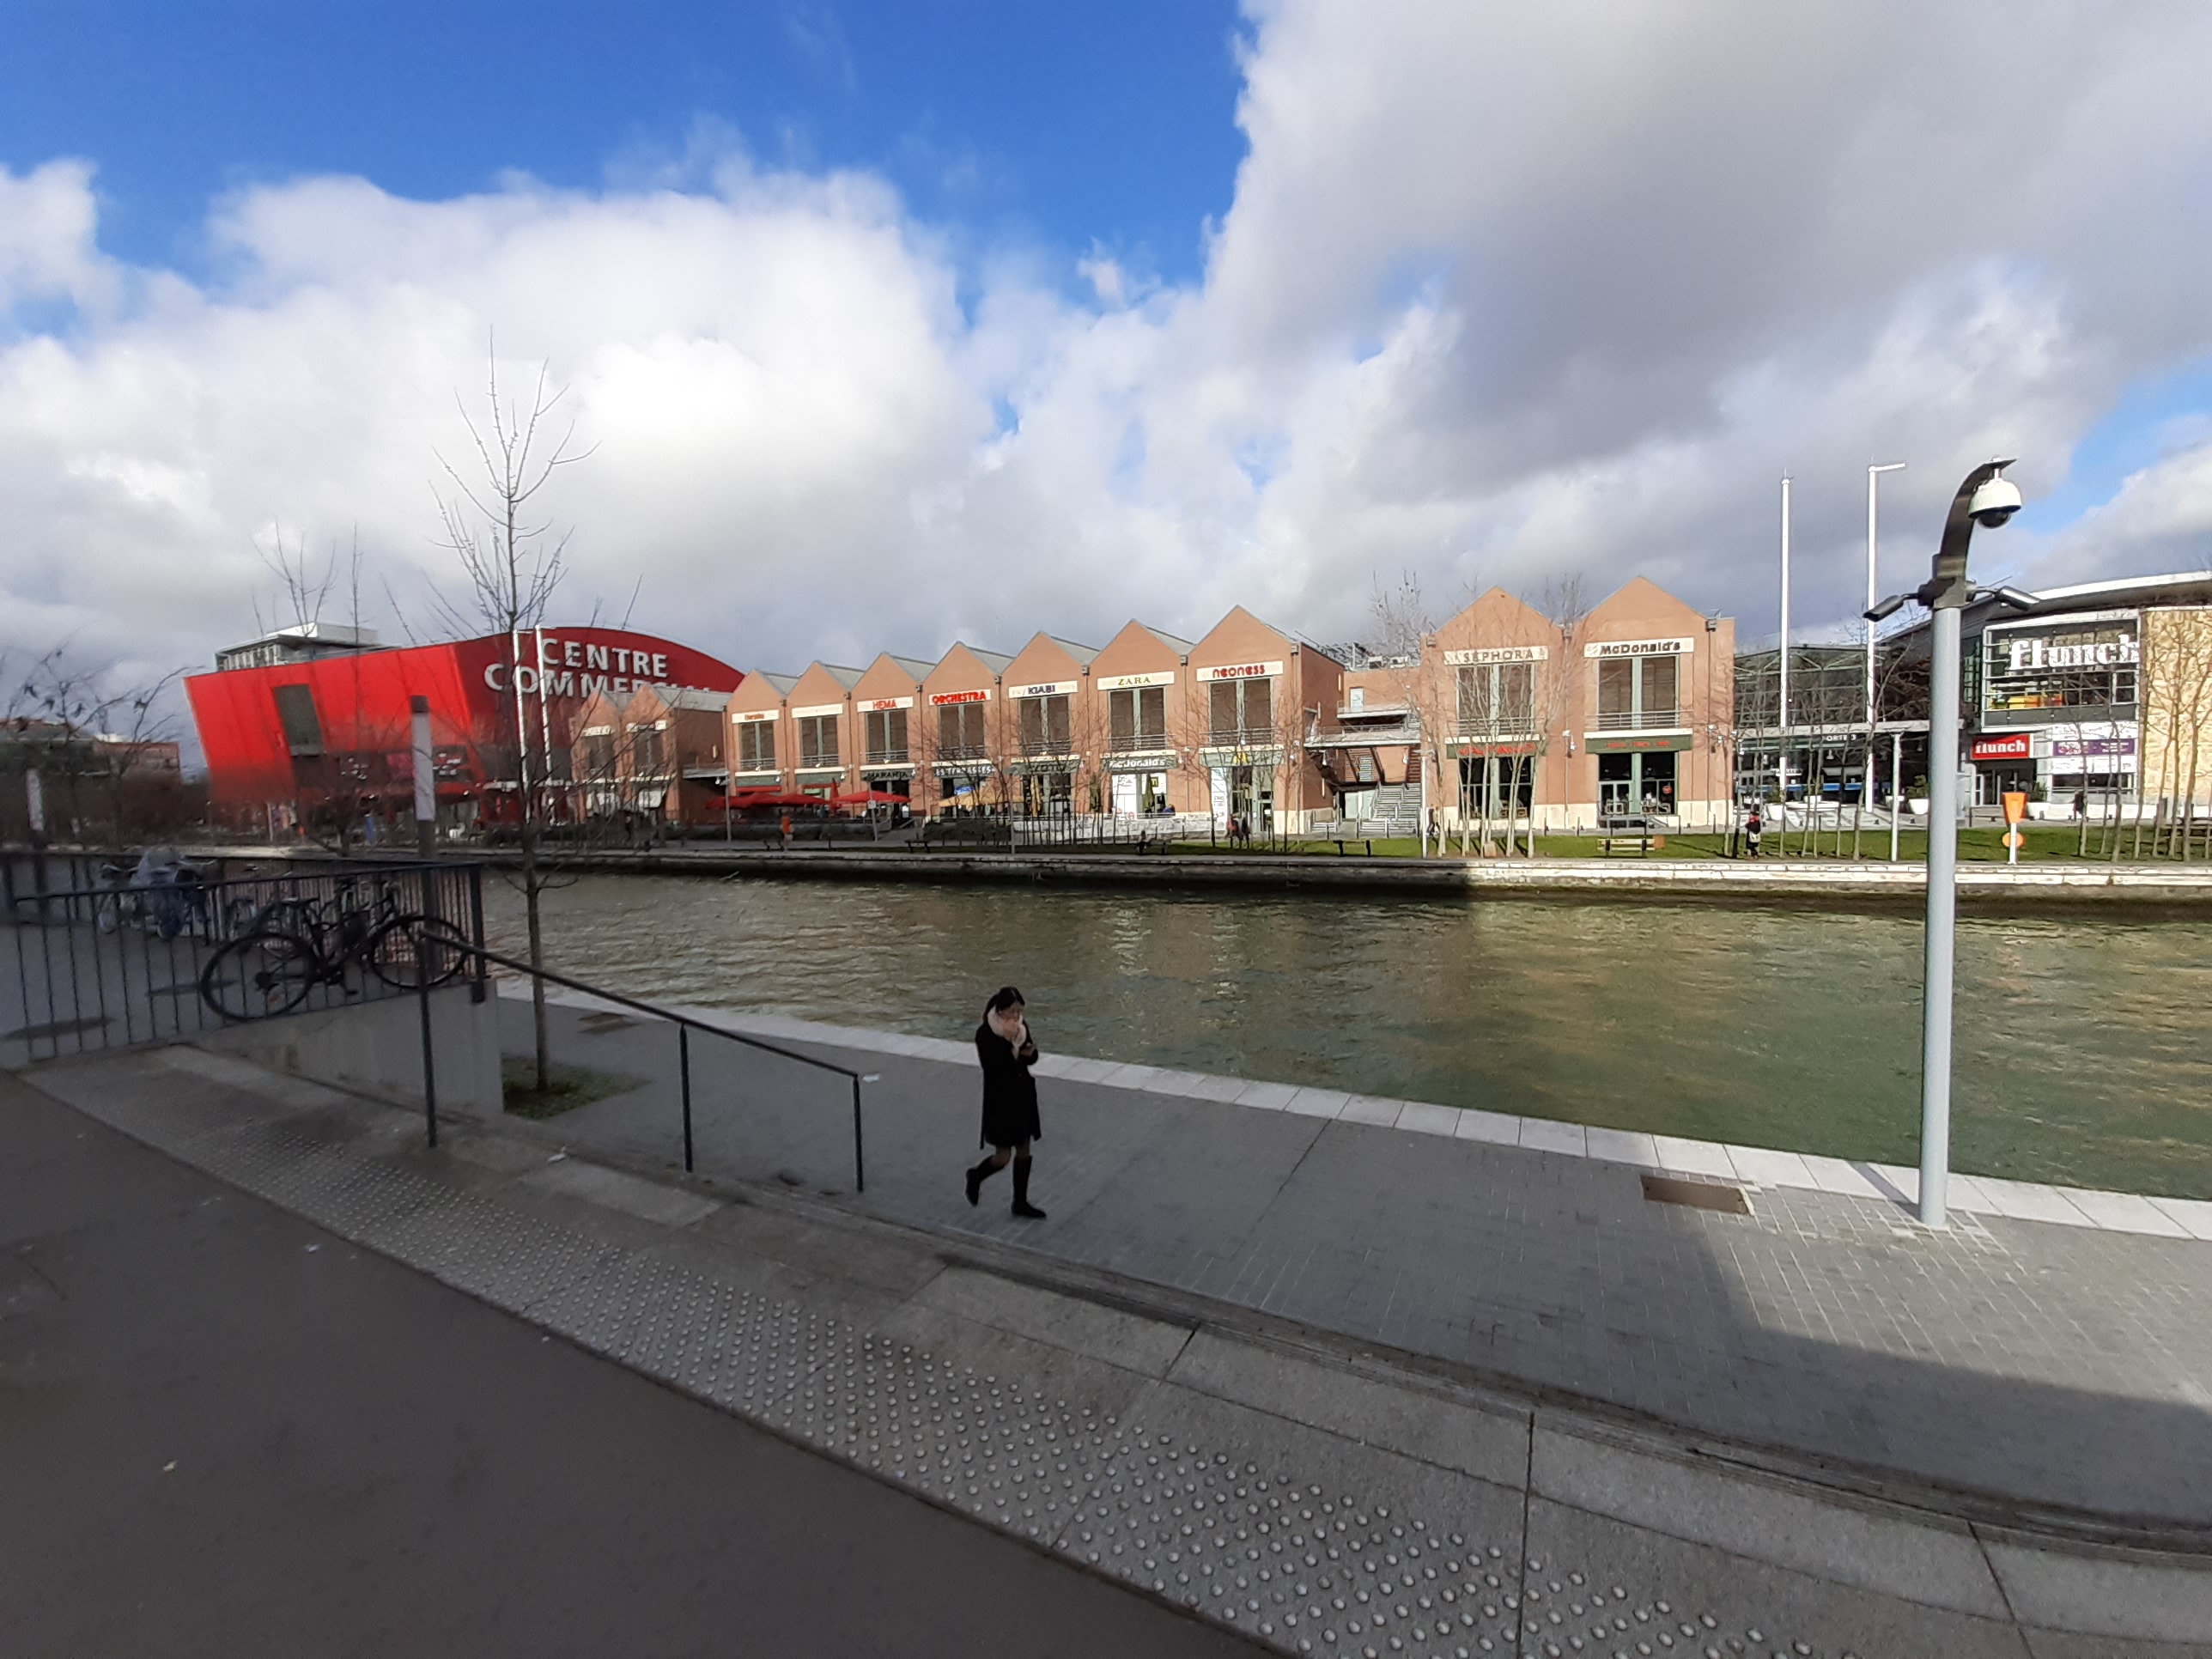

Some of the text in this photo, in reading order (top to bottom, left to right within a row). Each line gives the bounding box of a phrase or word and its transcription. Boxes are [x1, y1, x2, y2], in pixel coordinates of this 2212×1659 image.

[1599, 641, 1680, 655] McDonald's
[2005, 634, 2140, 670] flunch
[541, 638, 668, 678] CENTRE
[1463, 649, 1534, 663] SEPHORA
[1212, 664, 1266, 679] neoness
[1117, 676, 1152, 686] ZARA
[1027, 684, 1056, 695] KIABI
[872, 699, 897, 710] HEMA
[932, 690, 987, 705] ORCHESTRA
[1975, 739, 2027, 754] flunch
